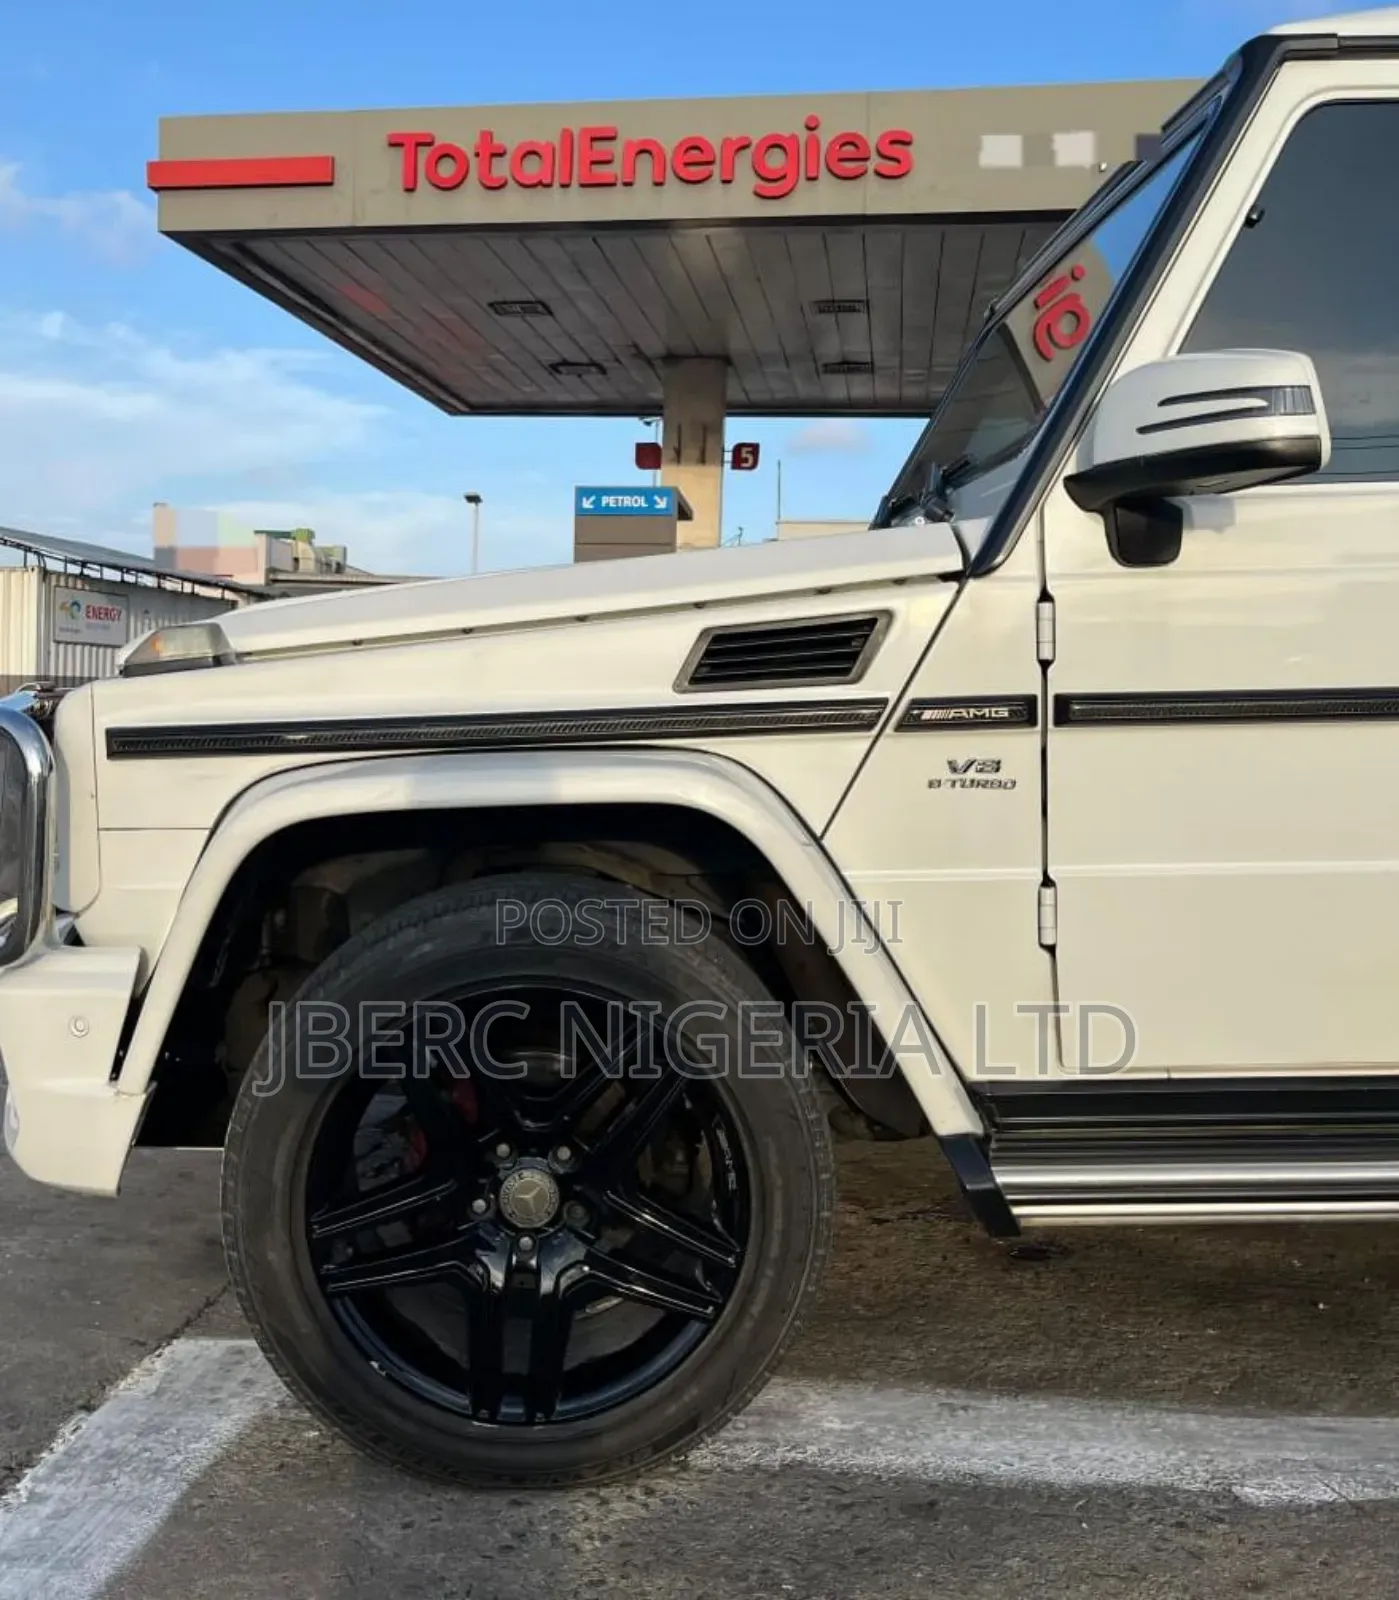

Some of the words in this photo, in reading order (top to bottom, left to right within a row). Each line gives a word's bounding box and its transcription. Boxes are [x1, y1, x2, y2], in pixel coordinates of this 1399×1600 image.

[387, 114, 914, 199] TotalEnergies
[740, 446, 754, 468] 5
[601, 495, 649, 508] PETROL
[85, 604, 122, 621] ENERGY
[947, 707, 1009, 719] AMG
